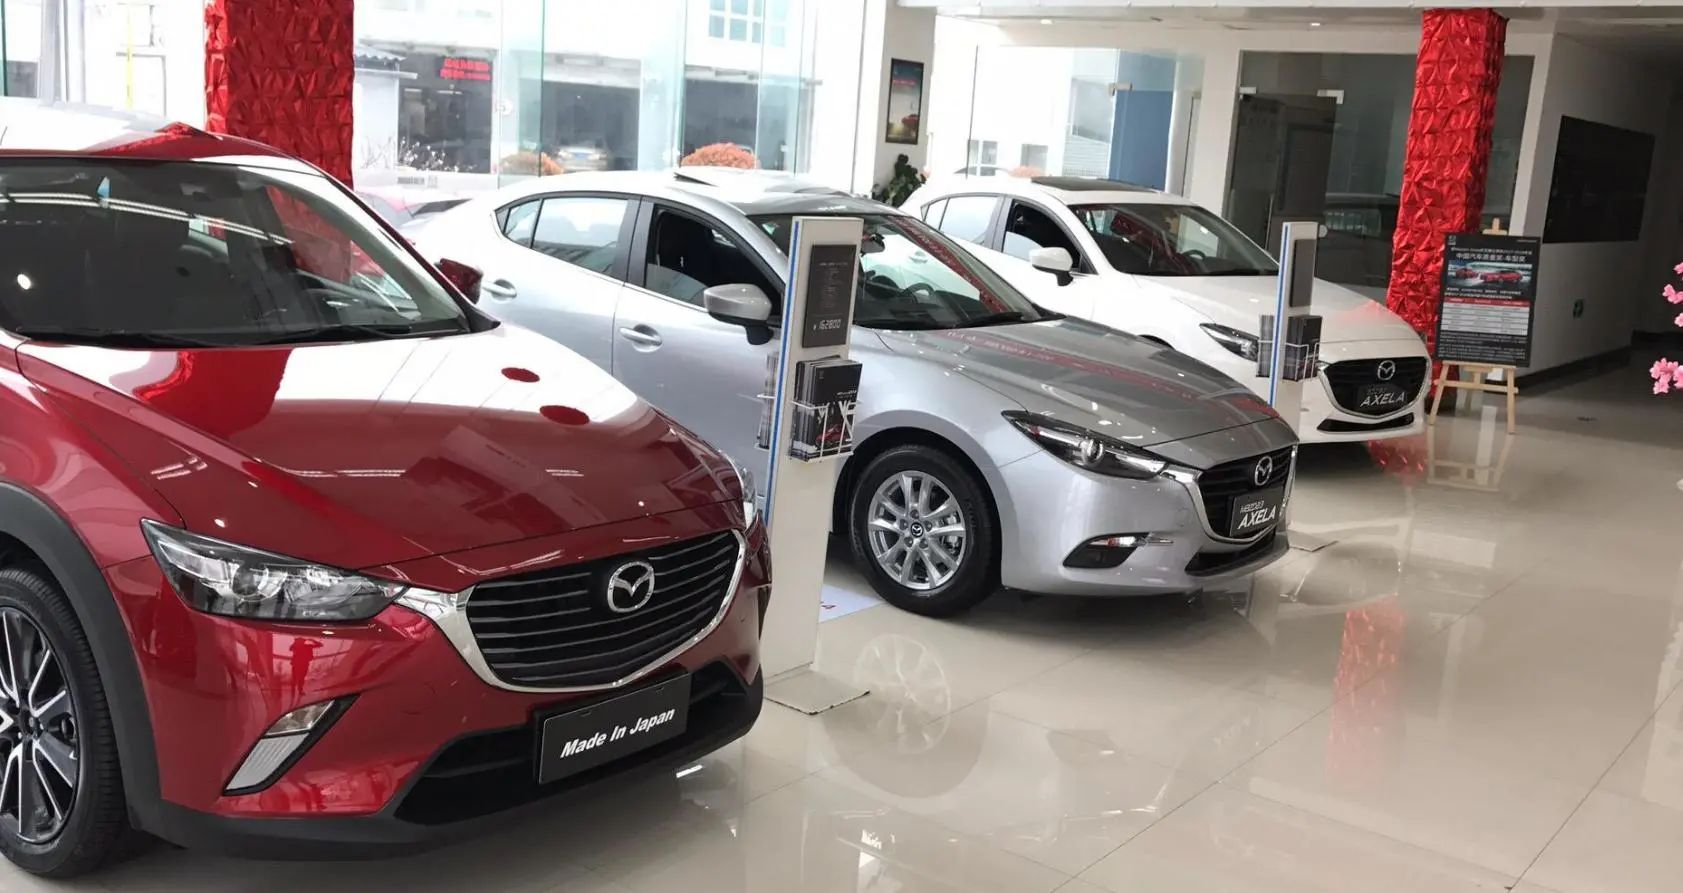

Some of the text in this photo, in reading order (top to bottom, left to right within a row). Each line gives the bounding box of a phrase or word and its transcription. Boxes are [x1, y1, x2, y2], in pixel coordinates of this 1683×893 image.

[1360, 391, 1405, 408] AXELA
[1237, 505, 1277, 530] AXELA
[560, 708, 676, 759] Made In Japan
